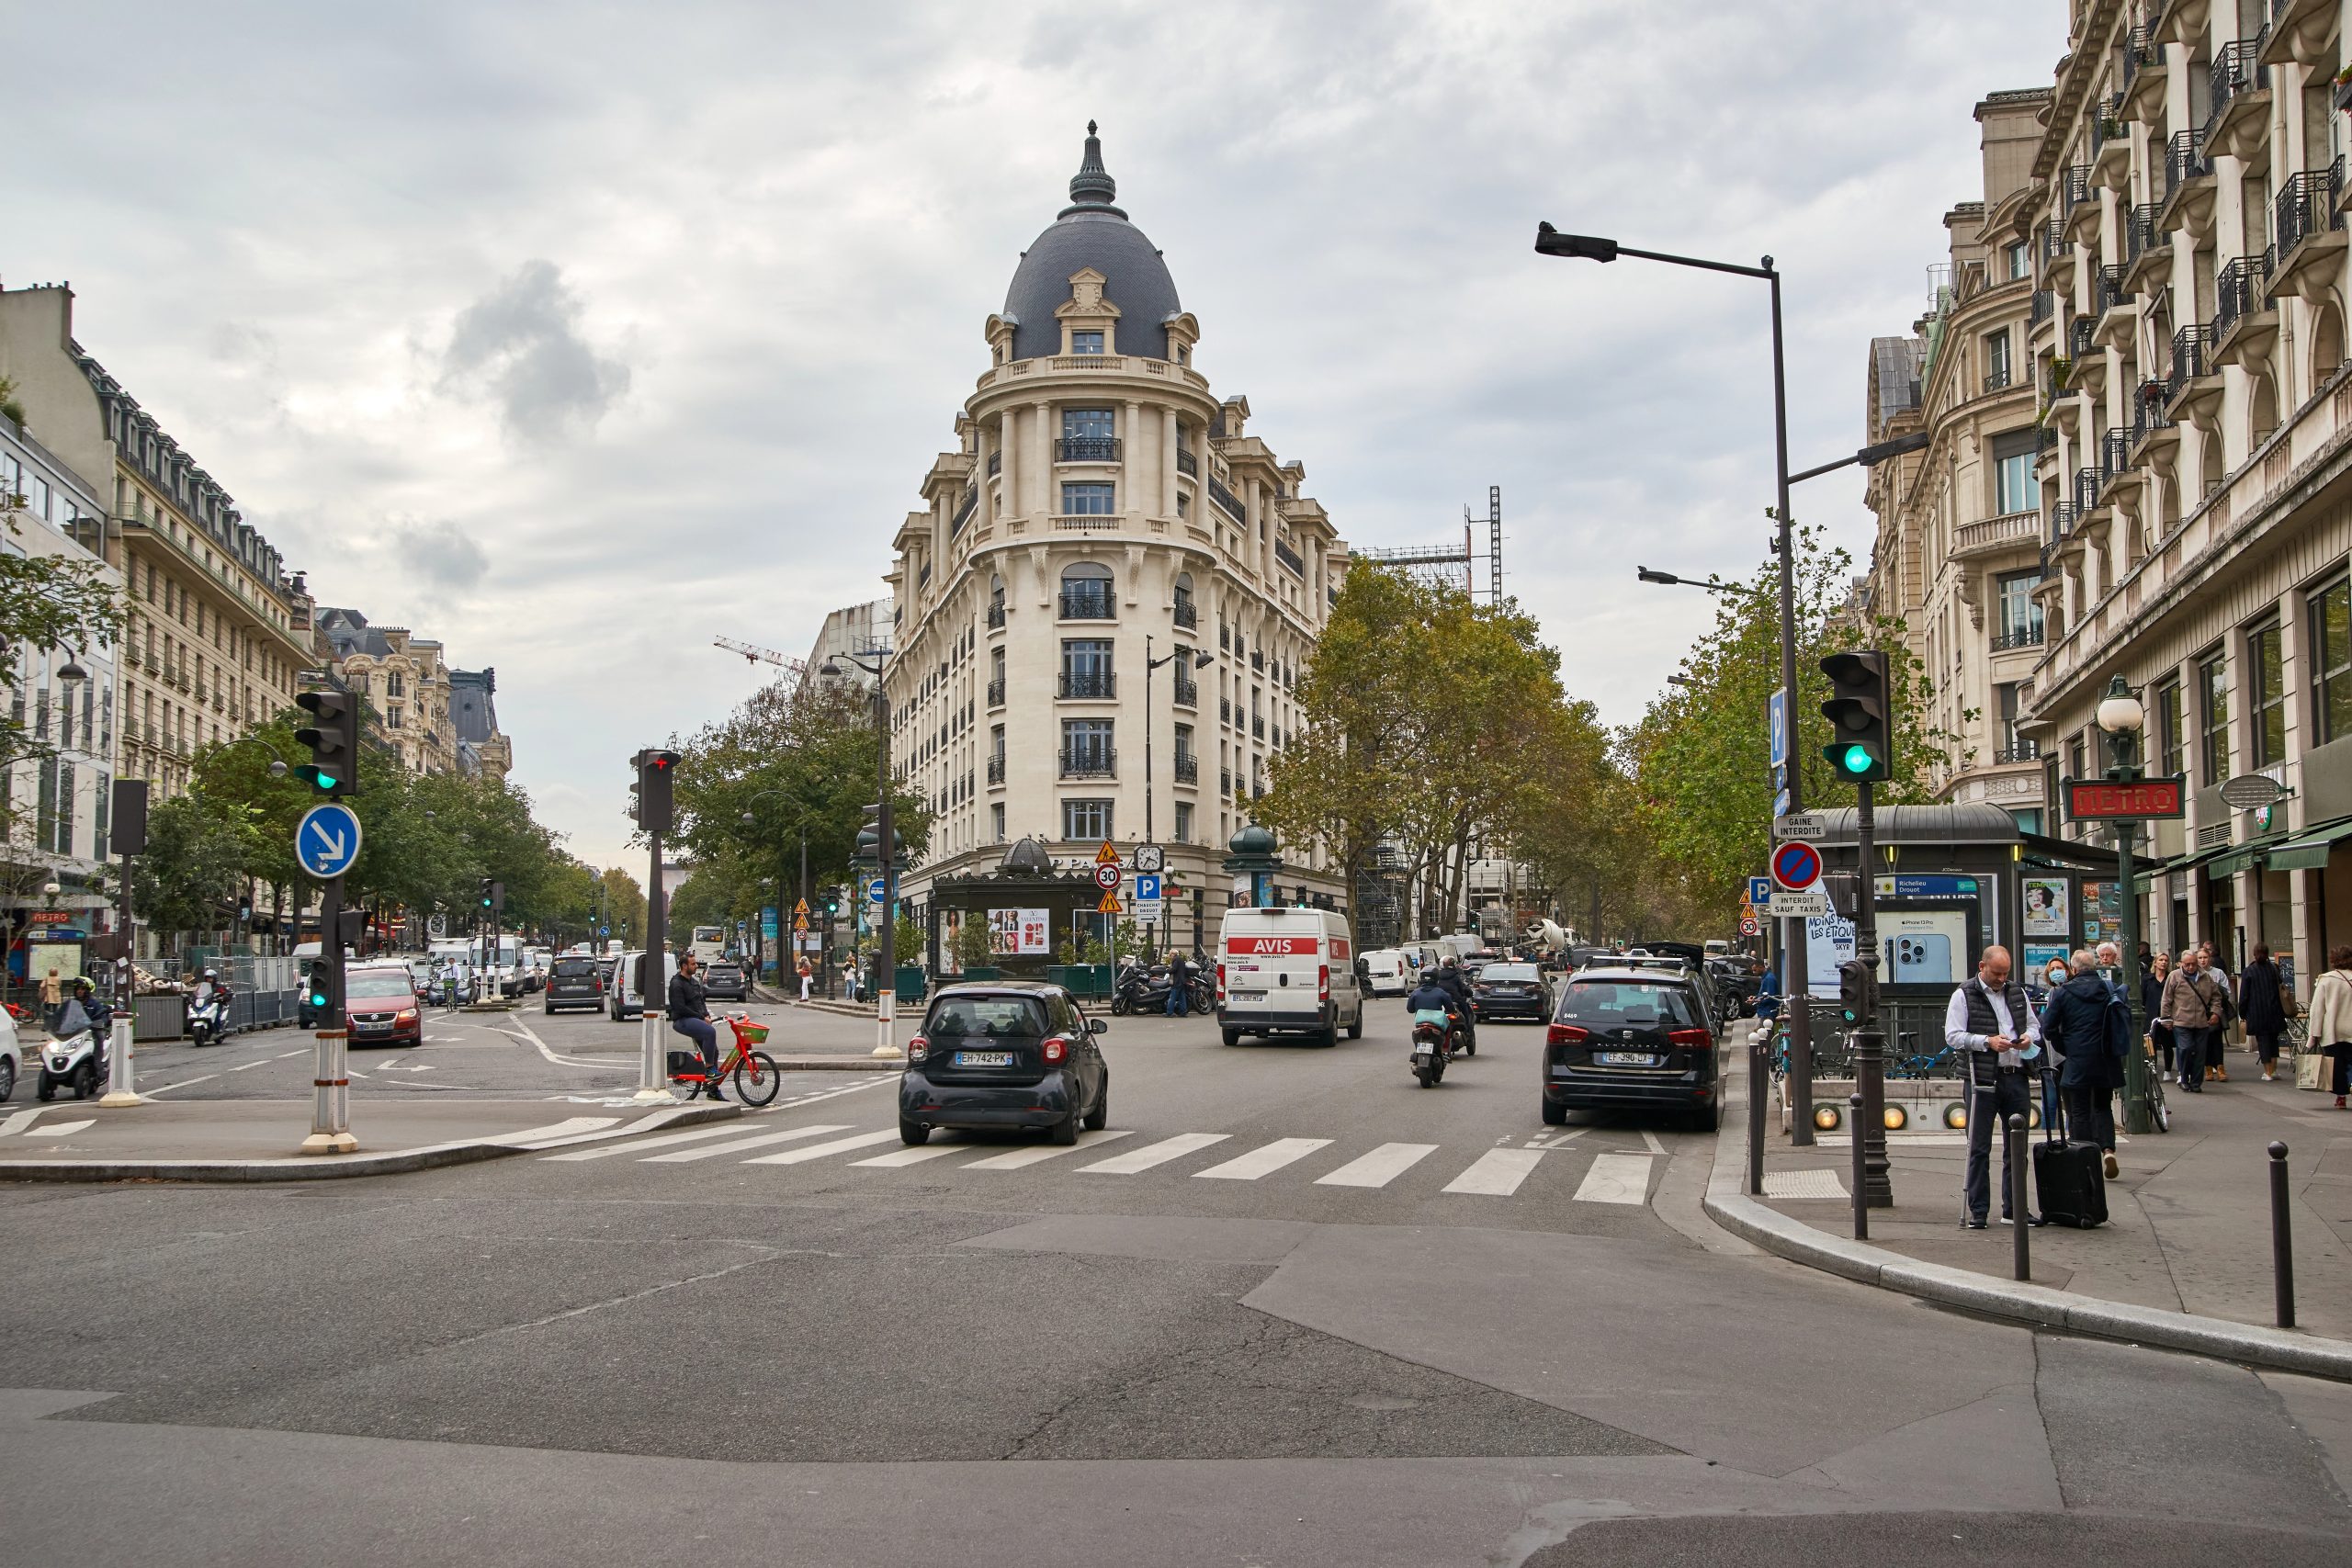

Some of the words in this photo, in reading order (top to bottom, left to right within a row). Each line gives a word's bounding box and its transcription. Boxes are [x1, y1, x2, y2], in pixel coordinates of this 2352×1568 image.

[1774, 706, 1781, 750] P
[2078, 788, 2171, 811] METRO
[1789, 818, 1812, 826] GAINE
[1781, 827, 1821, 835] INTERDITE
[1101, 871, 1115, 882] 30
[1142, 879, 1154, 896] P
[1757, 883, 1770, 900] P
[1811, 928, 1824, 940] LES
[1253, 939, 1292, 953] AVIS
[962, 1054, 1006, 1063] EH-742-PK
